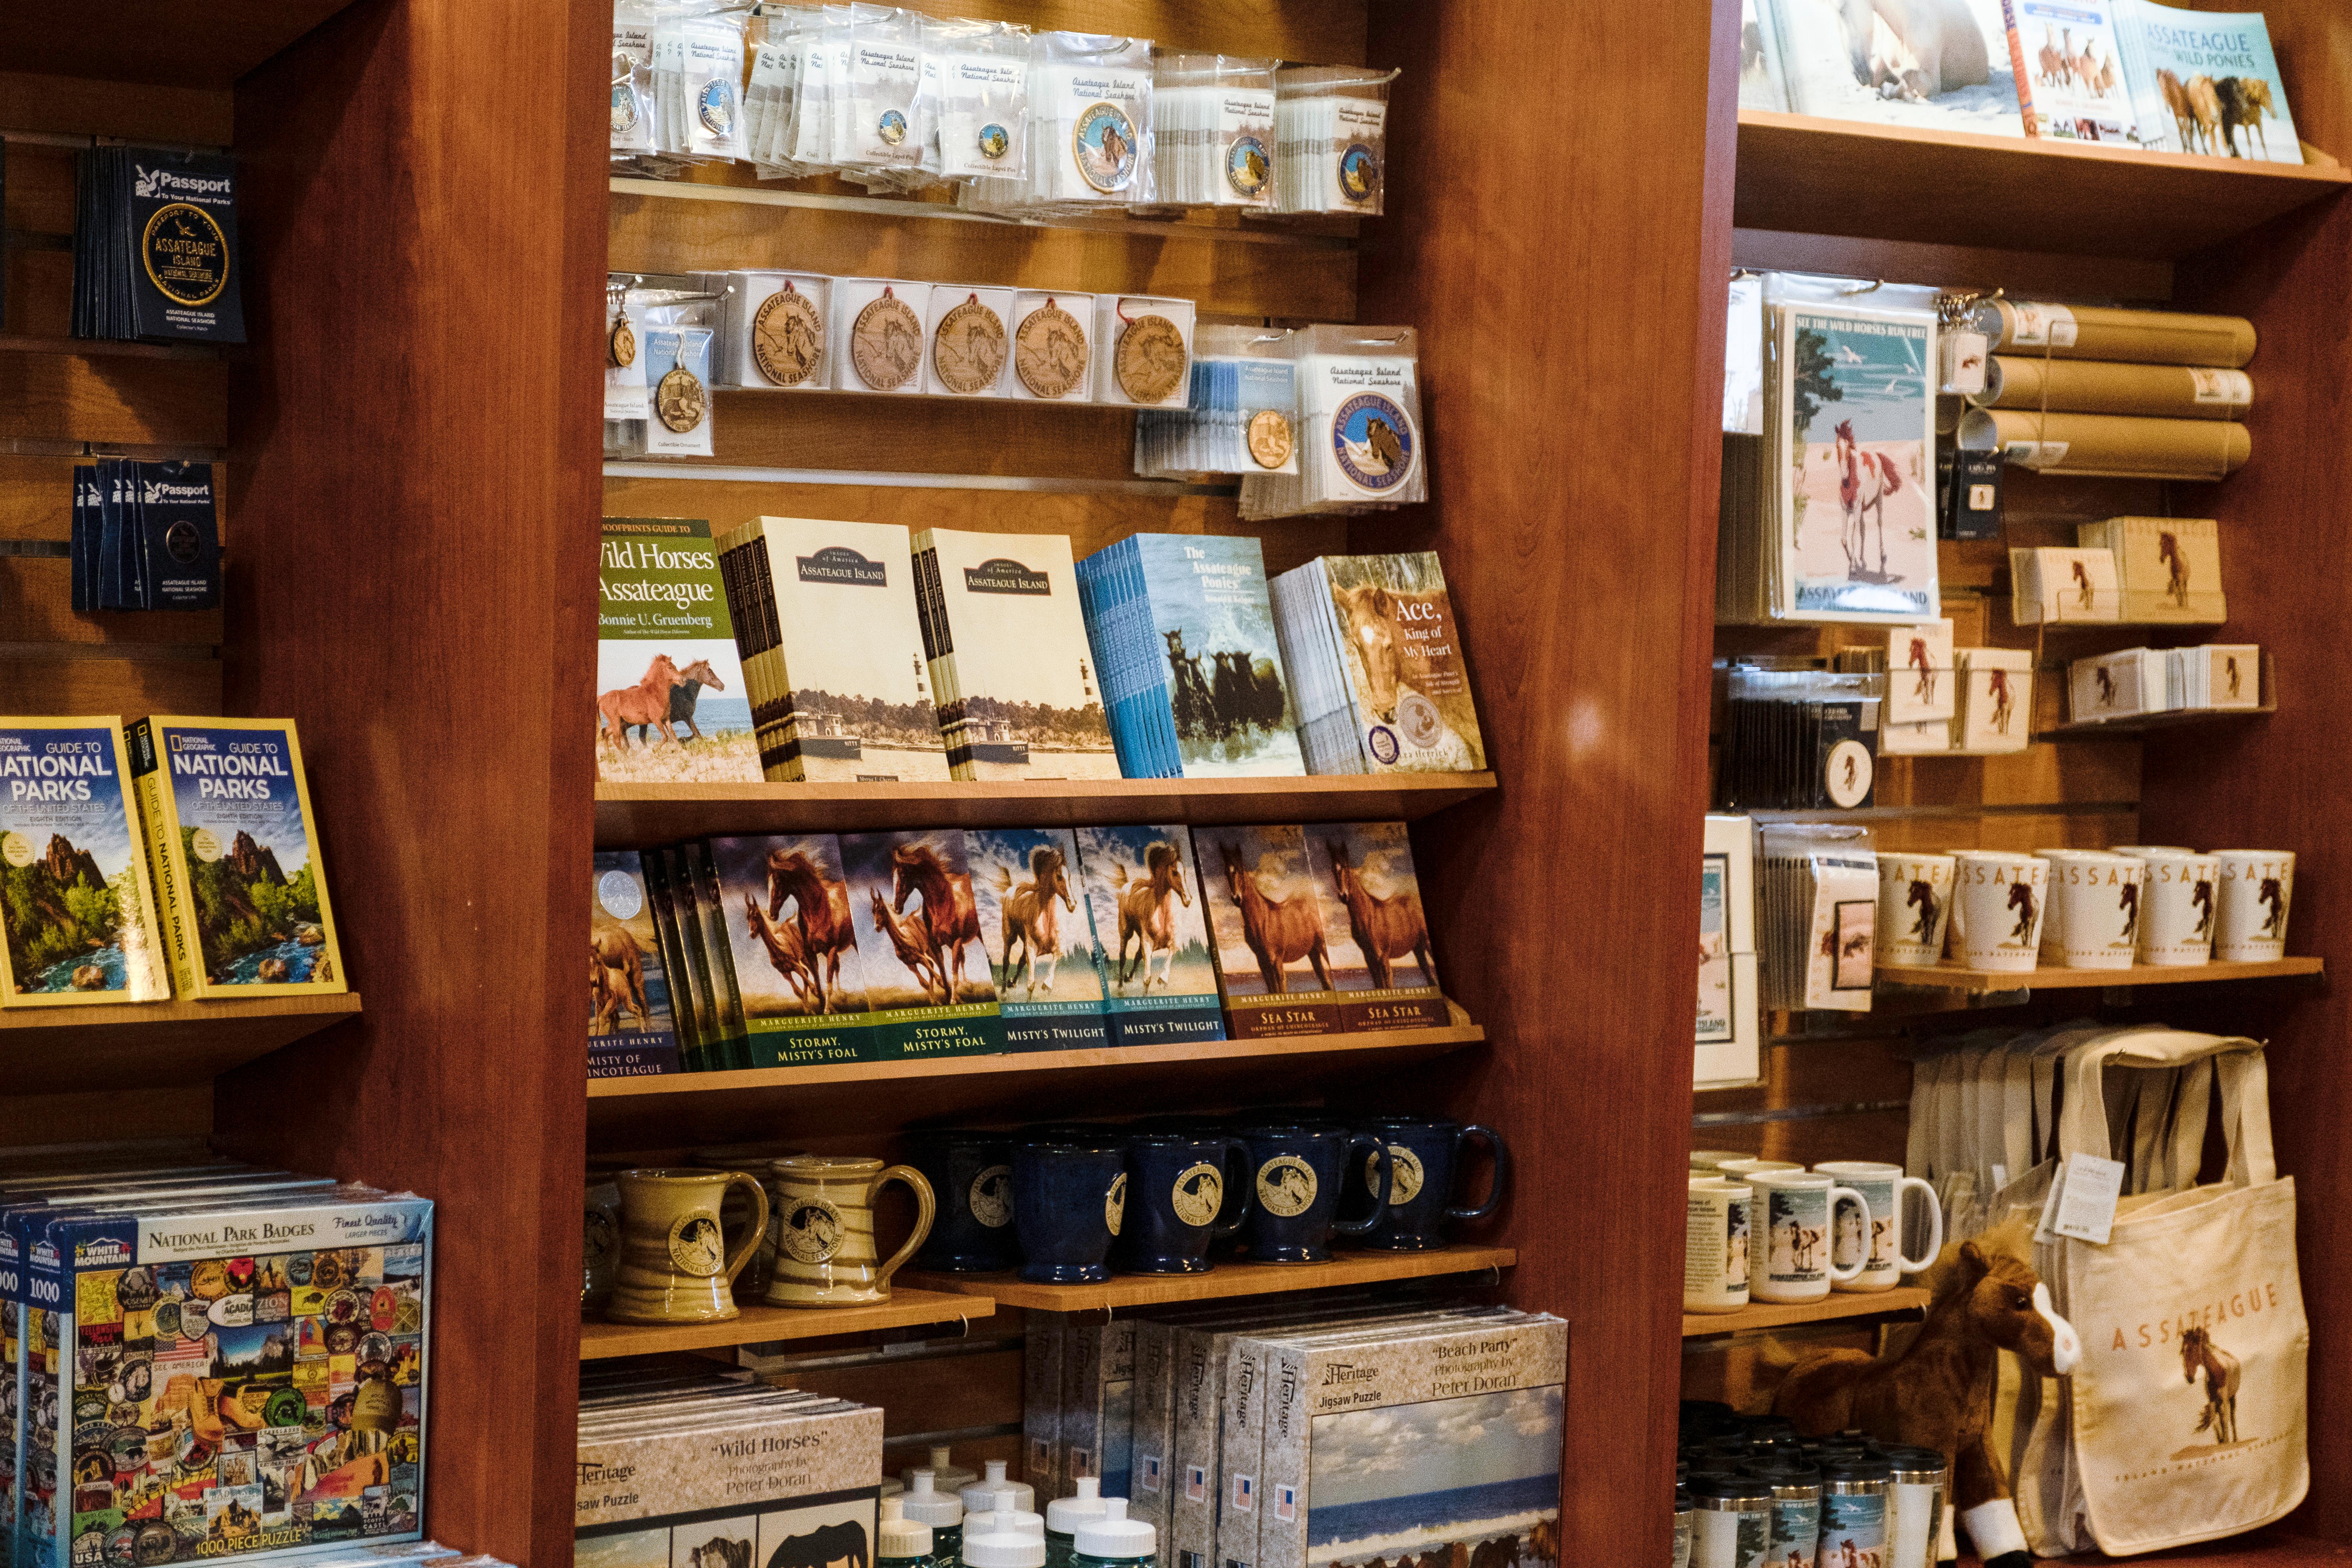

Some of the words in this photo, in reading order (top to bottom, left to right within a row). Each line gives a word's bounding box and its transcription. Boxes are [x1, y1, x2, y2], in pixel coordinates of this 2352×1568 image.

[2147, 23, 2250, 52] ASSATEAGUE
[691, 42, 720, 52] Assateague
[861, 49, 893, 60] Assateague
[896, 54, 915, 63] Island
[2174, 52, 2203, 66] WILD
[2207, 54, 2255, 68] PONIES
[962, 72, 989, 81] National
[1072, 77, 1110, 88] Assateague
[1113, 80, 1135, 89] Island
[1073, 88, 1102, 98] National
[161, 172, 231, 193] Passport
[186, 196, 211, 204] National
[156, 238, 217, 257] ASSATEAGUE
[173, 255, 201, 267] ISLAND
[757, 293, 800, 327] ASSATEAGUE
[802, 298, 822, 333] ISLAND
[1796, 317, 1811, 328] SEE
[1813, 319, 1828, 329] THE
[1830, 320, 1852, 332] WILD
[1854, 322, 1886, 335] HORSES
[1887, 325, 1906, 337] RUN
[1907, 327, 1927, 338] FREE
[757, 343, 786, 383] NATIONAL
[788, 346, 822, 383] SEASHORE
[1330, 367, 1373, 376] Assateague
[1376, 367, 1401, 376] Island
[162, 484, 208, 495] Passport
[652, 524, 677, 533] GUIDE
[637, 543, 714, 569] Horses
[1184, 546, 1205, 559] The
[801, 565, 853, 578] ASSATEAGUE
[855, 567, 884, 580] ISLAND
[1193, 560, 1252, 577] Assateague
[968, 576, 1017, 588] ASSATEAGUE
[1019, 577, 1048, 590] ISLAND
[1201, 576, 1240, 589] Ponies
[1397, 600, 1442, 622] Ace,
[599, 613, 636, 625] Bonnie
[637, 614, 651, 625] U.
[653, 613, 713, 628] Gruenberg
[1404, 628, 1429, 641] King
[1431, 626, 1442, 638] of
[1404, 646, 1419, 660] My
[1421, 644, 1452, 657] Heart
[46, 743, 82, 753] GUIDE
[84, 742, 101, 753] TO
[229, 743, 261, 753] GUIDE
[263, 743, 278, 753] TO
[0, 756, 112, 776] ATIONAL
[173, 755, 288, 776] NATIONAL
[11, 780, 91, 801] PARKS
[199, 778, 271, 799] PARKS
[147, 777, 161, 818] GUIDE
[253, 801, 283, 810] STATES
[155, 822, 164, 841] TO
[159, 842, 176, 913] NATIONAL
[172, 916, 186, 961] PARKS
[1007, 1003, 1065, 1013] MARGUERITE
[1124, 997, 1179, 1007] MARGUERITE
[1182, 995, 1210, 1004] HENRY
[886, 1006, 951, 1018] MARGUERITE
[955, 1004, 988, 1012] HENRY
[1261, 1012, 1282, 1024] SEA
[1286, 1011, 1315, 1023] STAR
[1369, 1007, 1390, 1019] SEA
[1393, 1006, 1421, 1017] STAR
[760, 1017, 824, 1027] MARGUERITE
[828, 1015, 861, 1023] HENRY
[1124, 1022, 1164, 1035] MISTY'S
[1167, 1020, 1219, 1033] TWILIGHT
[916, 1026, 968, 1040] STORMY,
[1008, 1028, 1049, 1041] MISTY'S
[1052, 1027, 1105, 1040] TWILIGHT
[790, 1037, 841, 1049] STORMY,
[904, 1038, 952, 1052] MISTY'S
[956, 1036, 986, 1047] FOAL
[587, 1056, 622, 1066] MISTY
[626, 1055, 640, 1064] OF
[778, 1049, 824, 1062] MISTY'S
[828, 1048, 858, 1058] FOAL
[587, 1065, 662, 1077] INCOTEAGUE
[333, 1216, 361, 1230] Finest
[365, 1214, 400, 1229] Quality
[149, 1232, 218, 1248] NATIONAL
[224, 1227, 257, 1242] PARK
[263, 1223, 314, 1239] BADGES
[37, 1247, 54, 1257] WHITE
[87, 1245, 119, 1256] WHITE
[75, 1253, 131, 1267] MOUNTAIN
[30, 1278, 60, 1302] 1000
[2112, 1283, 2278, 1352] ASSATEAGUE
[1322, 1363, 1380, 1386] Heritage
[1435, 1359, 1497, 1377] Photography
[1501, 1357, 1514, 1369] by
[1237, 1348, 1255, 1429] Heritage
[1432, 1380, 1470, 1397] Peter
[1474, 1374, 1517, 1391] Doran
[1279, 1357, 1297, 1438] Heritage
[1320, 1395, 1351, 1409] Jigsaw
[1353, 1390, 1381, 1403] Puzzle
[729, 1458, 794, 1477] Photography
[796, 1458, 808, 1470] by
[726, 1477, 764, 1495] Peter
[769, 1474, 812, 1489] Doran
[577, 1499, 600, 1511] saw
[603, 1492, 639, 1507] Puzzle
[196, 1539, 225, 1554] 1000
[228, 1535, 259, 1550] PIECE
[261, 1530, 302, 1546] PUZZLE
[76, 1553, 103, 1563] USA
